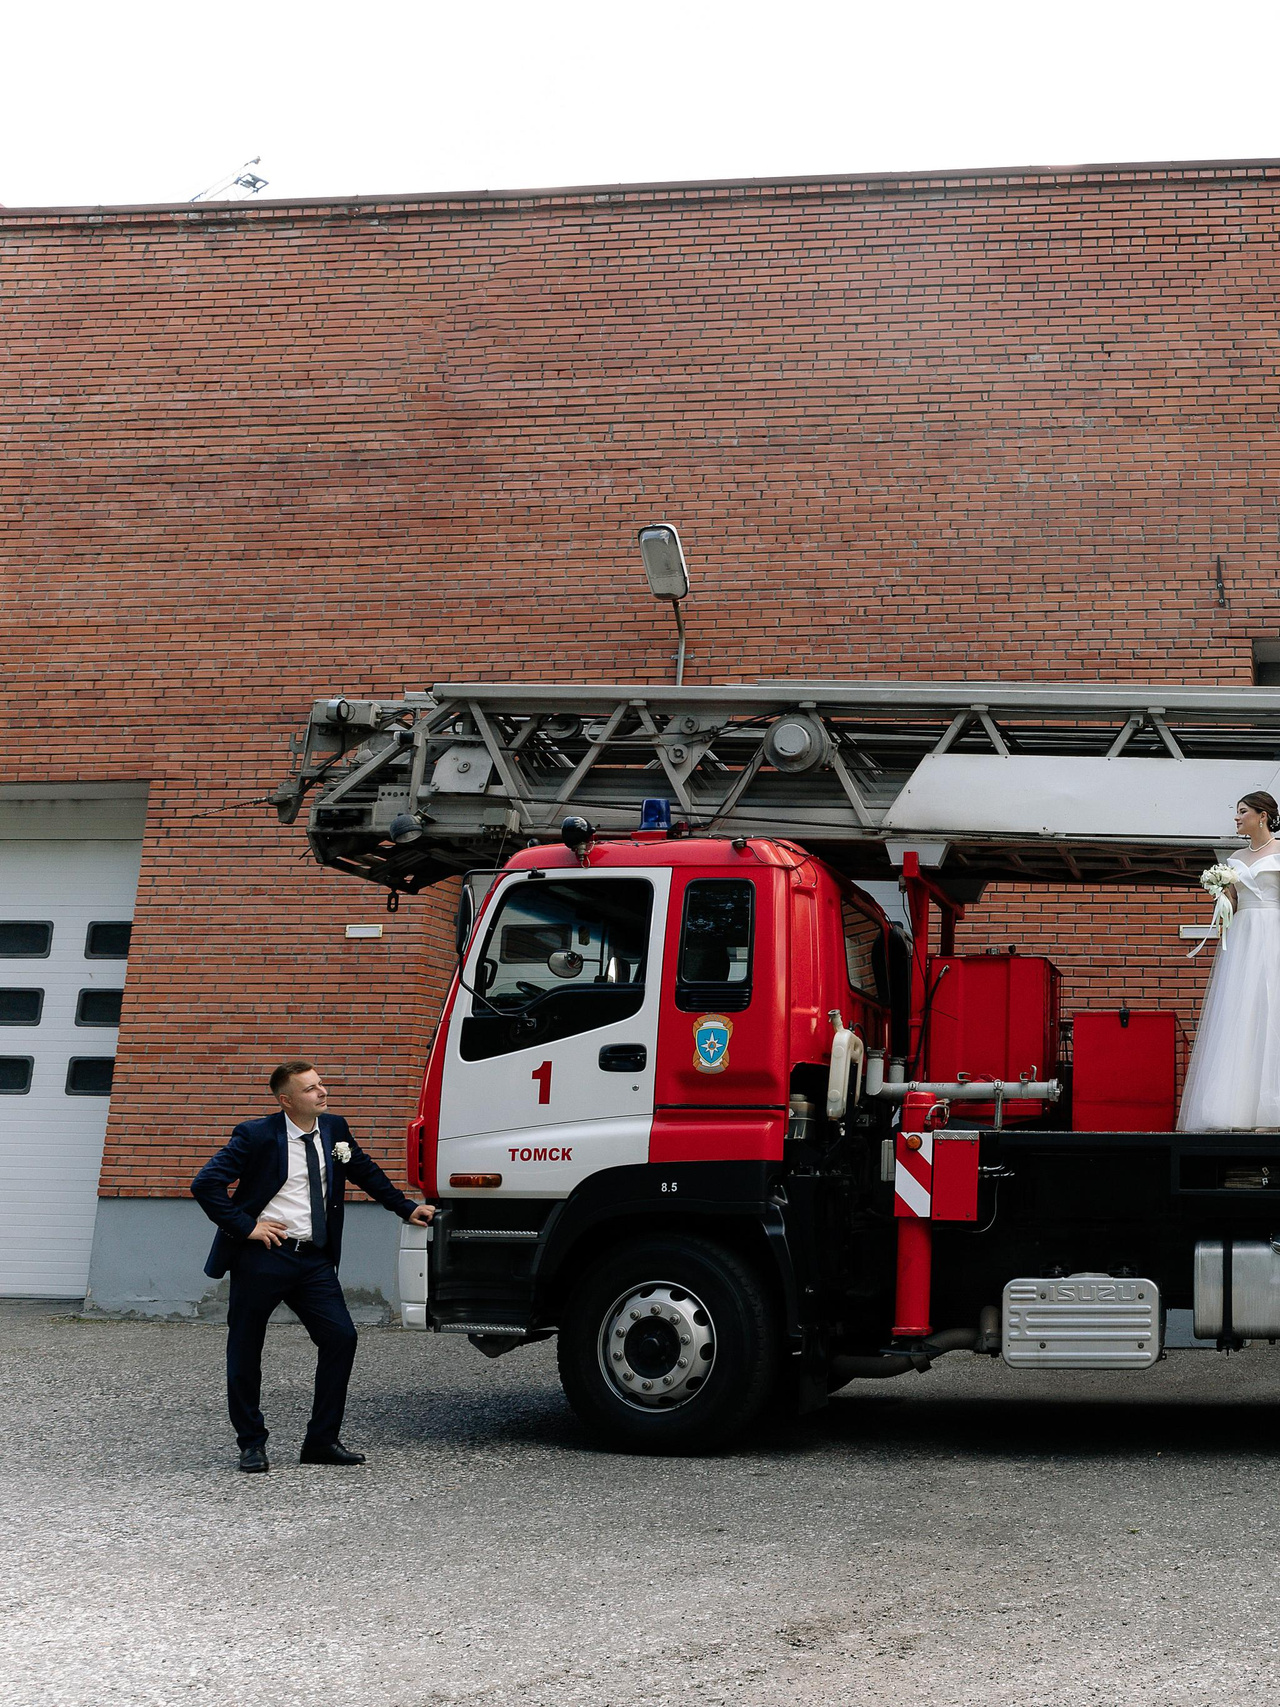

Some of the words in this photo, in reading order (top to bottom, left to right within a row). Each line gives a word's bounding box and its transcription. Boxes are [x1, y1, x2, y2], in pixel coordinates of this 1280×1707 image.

[532, 1061, 552, 1105] 1
[508, 1147, 573, 1162] ТОМСК
[661, 1182, 678, 1193] 8.5
[1049, 1285, 1137, 1301] ISUZU
